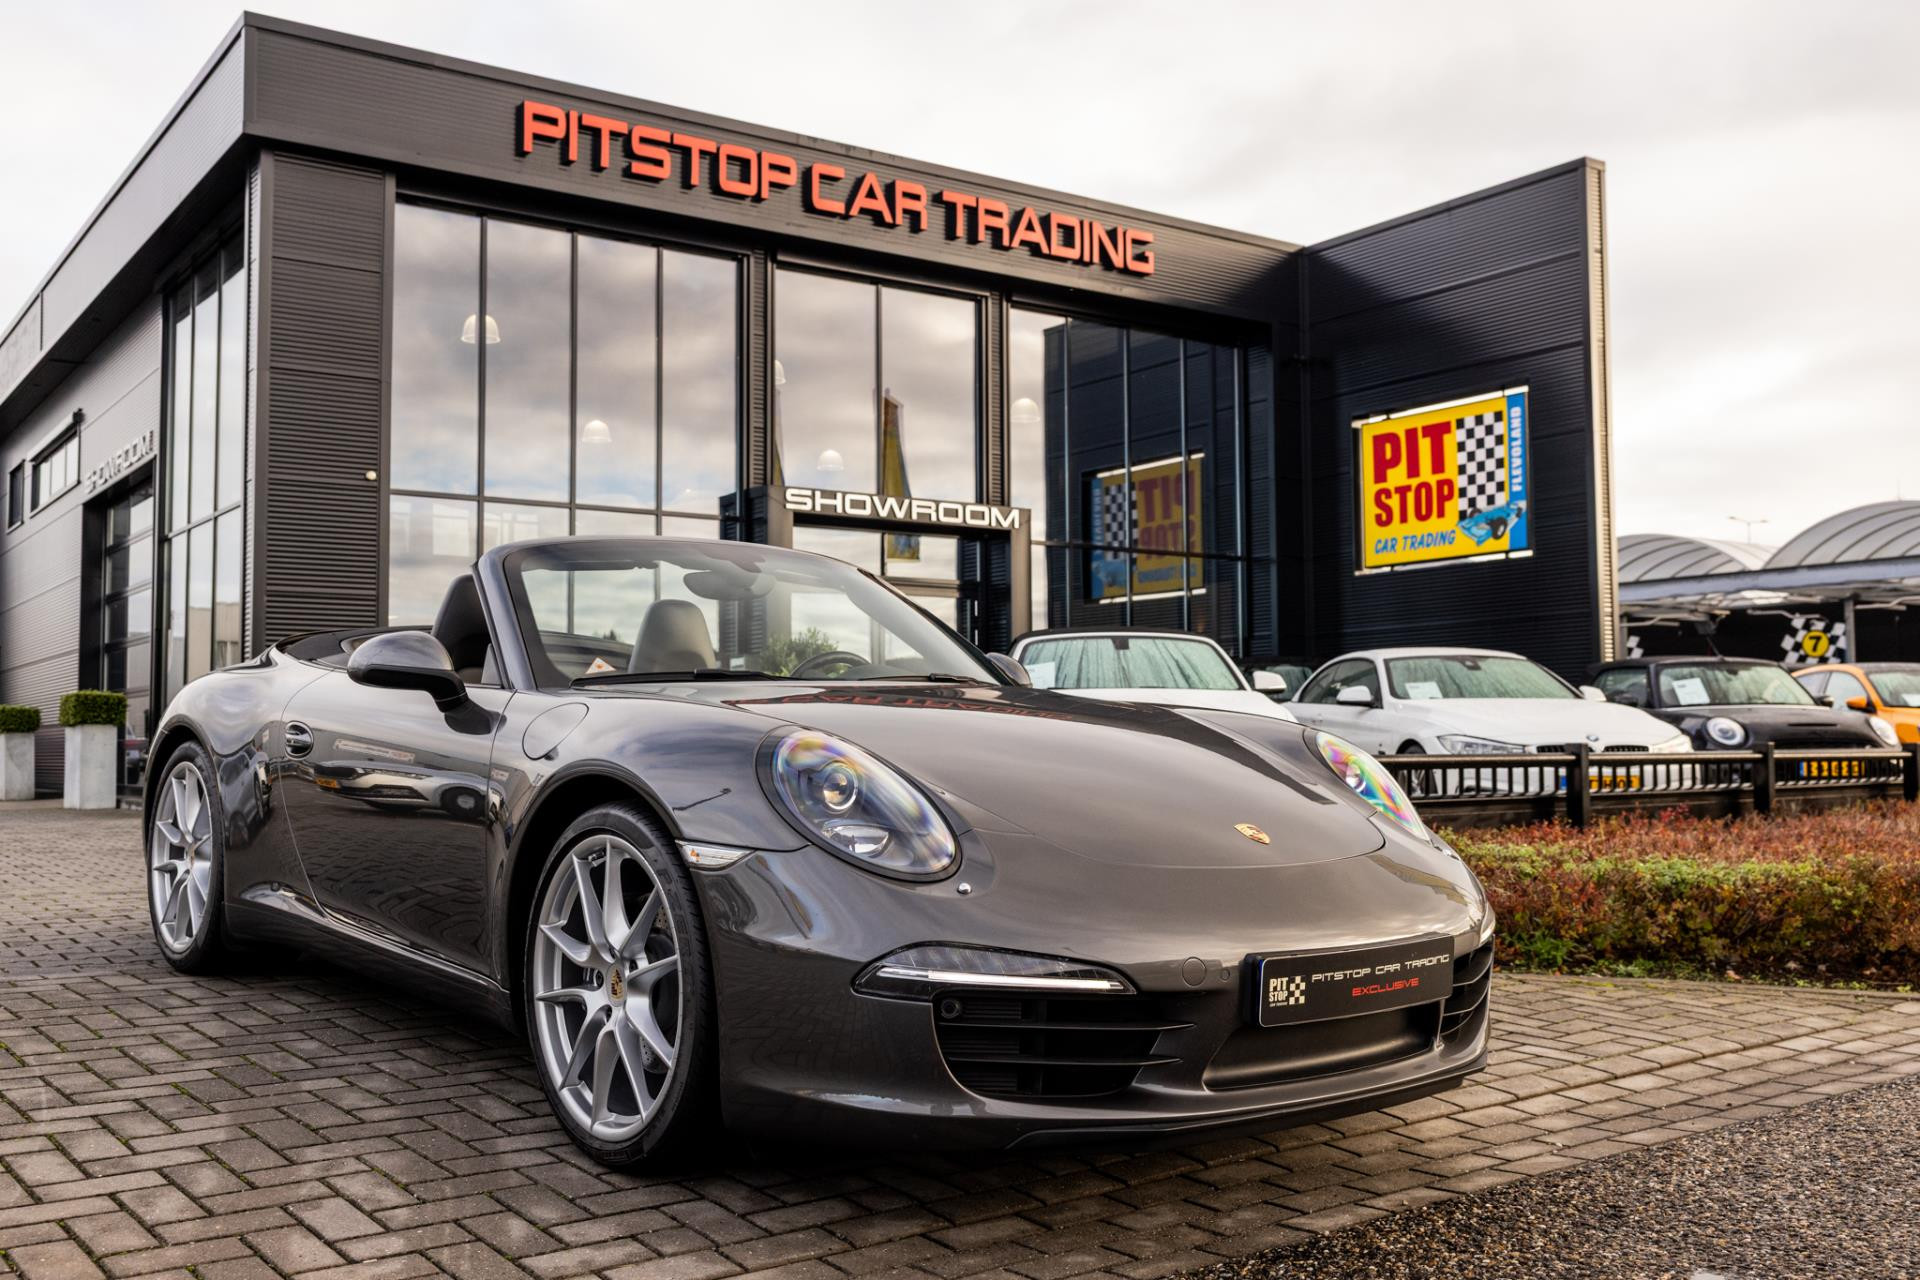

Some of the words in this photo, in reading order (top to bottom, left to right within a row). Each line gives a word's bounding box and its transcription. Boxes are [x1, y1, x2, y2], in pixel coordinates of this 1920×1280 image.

[522, 100, 798, 200] PITSTOP
[811, 162, 929, 231] CAR
[942, 189, 1155, 275] TRADING
[1372, 420, 1452, 485] PIT
[1509, 406, 1523, 492] FLEVOLAND
[784, 488, 1020, 530] SHOWROOM
[1373, 478, 1455, 528] STOP
[1374, 537, 1399, 555] CAR
[1402, 529, 1457, 550] TRADING
[1809, 635, 1822, 653] 7
[1311, 967, 1372, 983] PITSTOP
[1375, 962, 1401, 975] CAR
[1404, 953, 1450, 971] TRADING
[1268, 991, 1289, 1003] STOP
[1269, 977, 1289, 992] PIT
[1351, 977, 1420, 997] EXCLUSIVE
